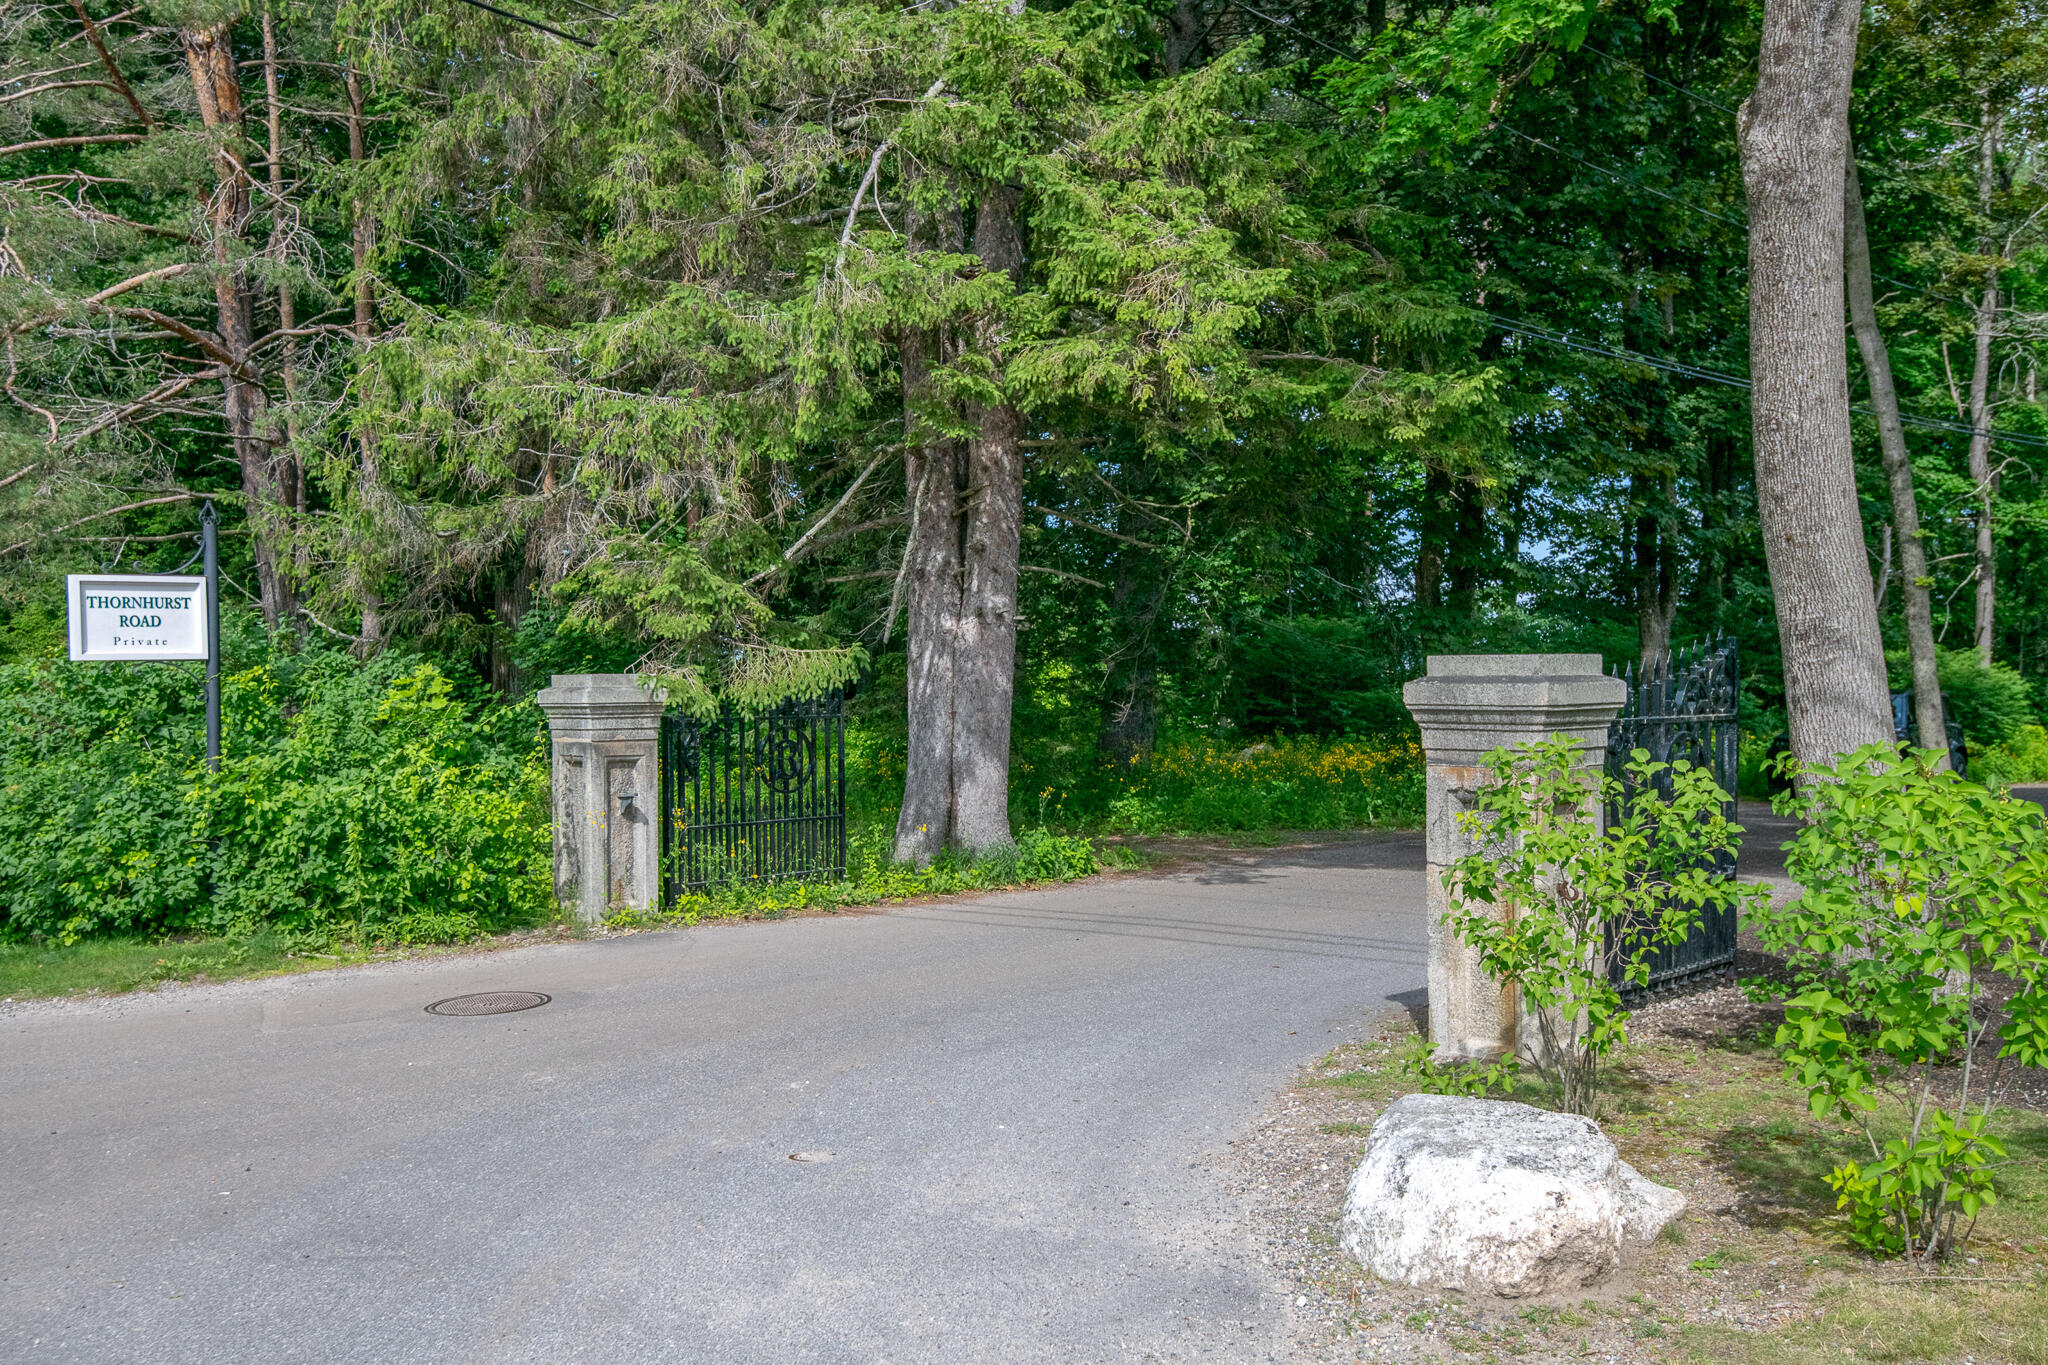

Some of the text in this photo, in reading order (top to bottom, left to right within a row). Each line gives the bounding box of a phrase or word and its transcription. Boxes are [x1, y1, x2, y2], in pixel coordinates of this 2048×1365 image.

[86, 596, 191, 610] THORNHURST
[119, 615, 162, 628] ROAD
[113, 636, 168, 646] Private
